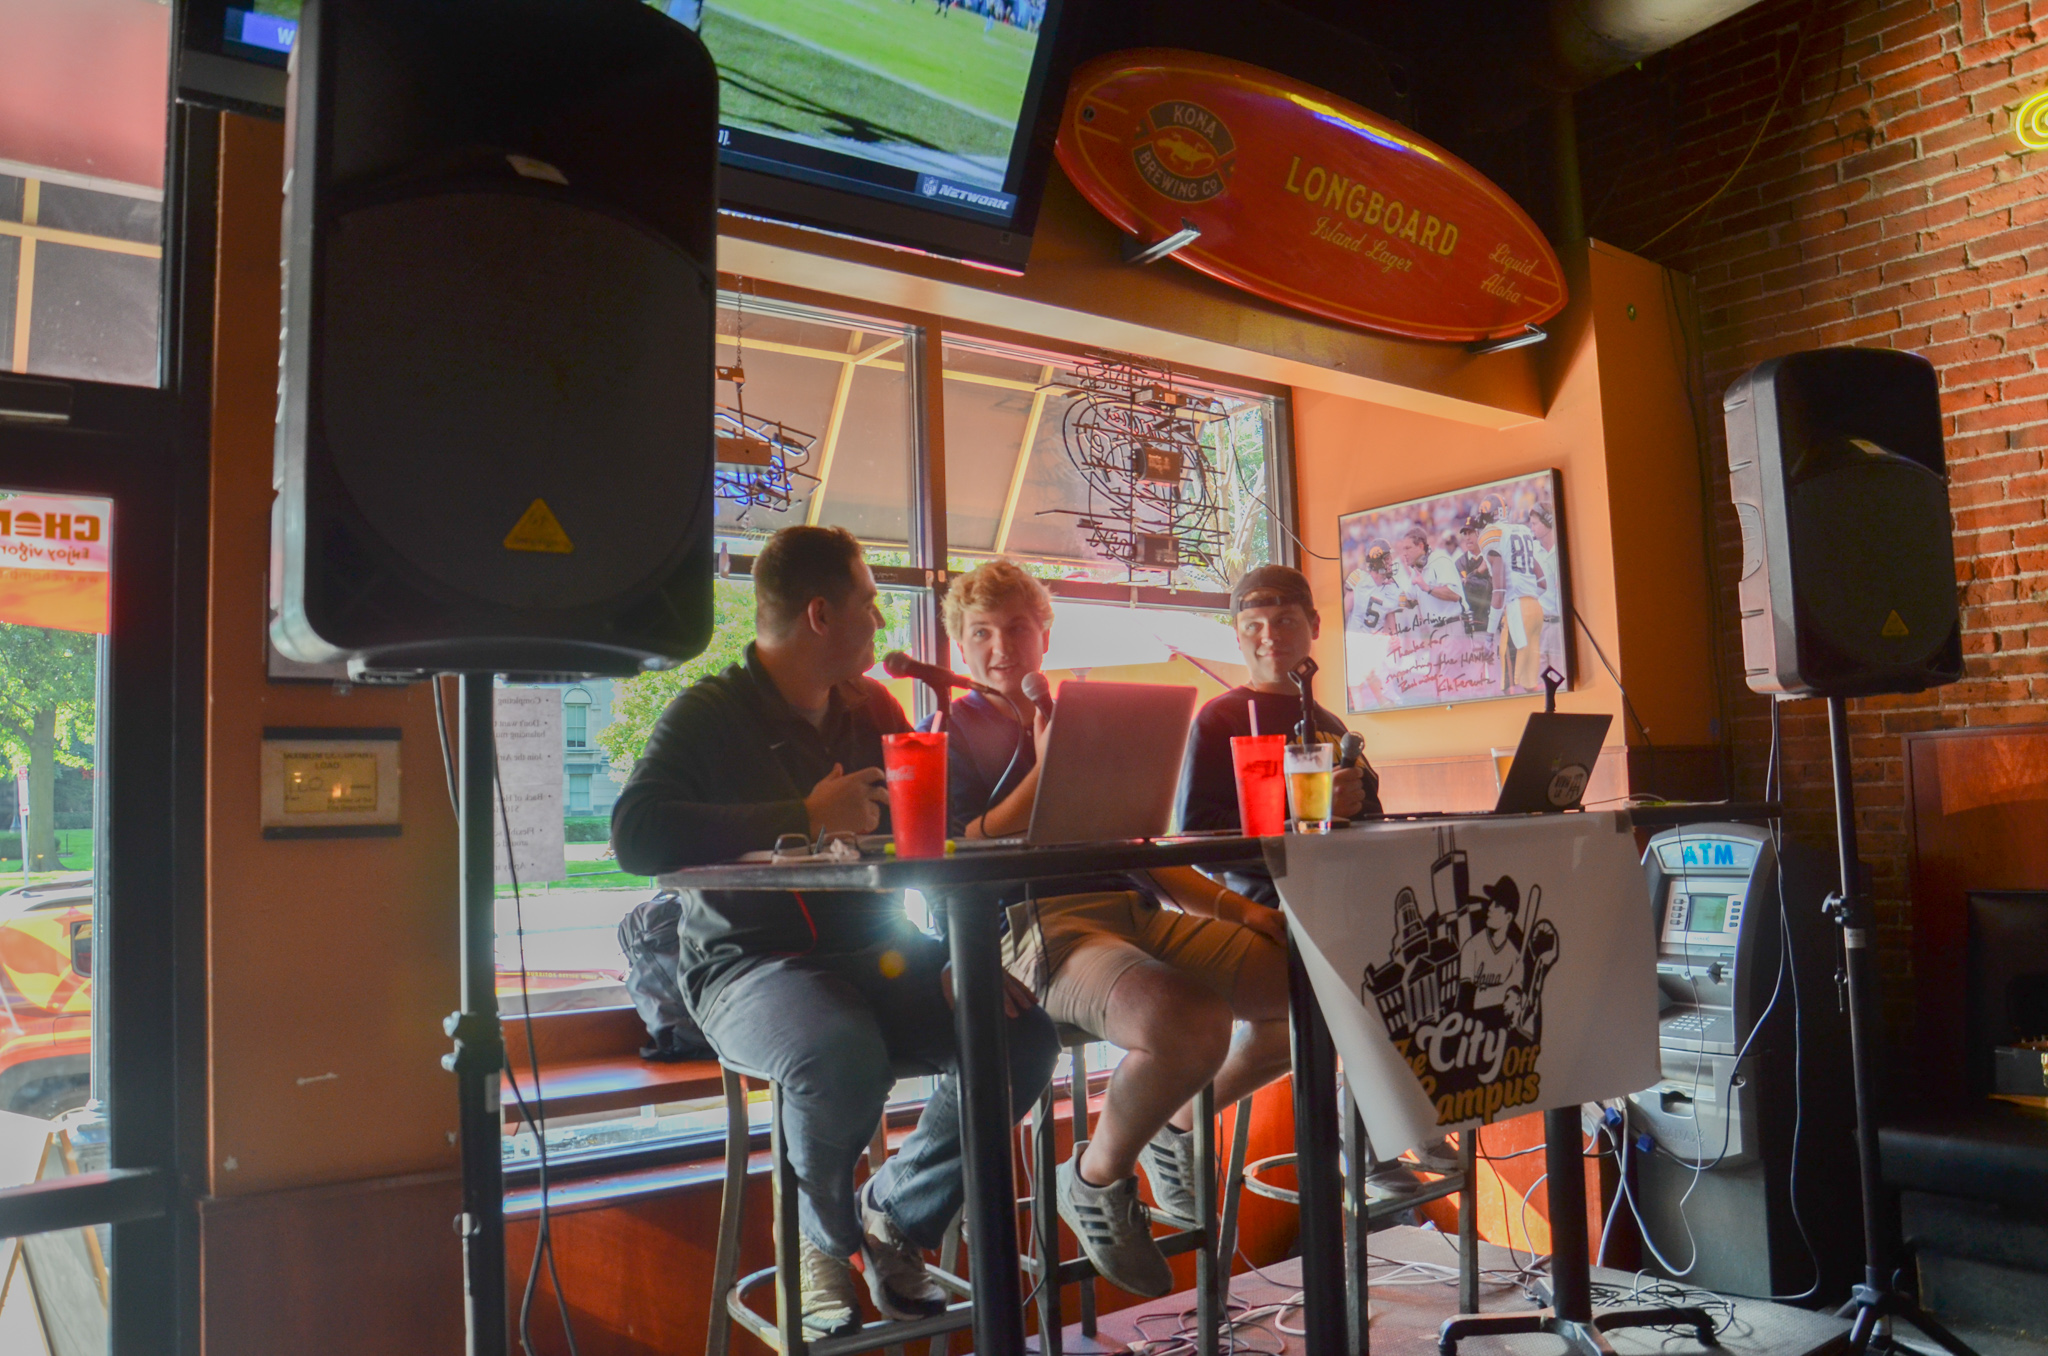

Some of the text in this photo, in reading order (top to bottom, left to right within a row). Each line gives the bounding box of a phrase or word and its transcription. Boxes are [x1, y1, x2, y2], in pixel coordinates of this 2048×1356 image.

[1173, 104, 1217, 139] KONA
[1139, 150, 1197, 198] BREWING
[938, 184, 1010, 210] NETWORK
[1284, 155, 1459, 257] LONGBOARD
[1310, 215, 1413, 273] Island Lager
[1488, 242, 1540, 276] Liquid
[1480, 273, 1521, 304] Aloha
[1364, 596, 1384, 628] 5
[1683, 842, 1734, 865] ATM
[1415, 1012, 1508, 1083] City
[1502, 1045, 1540, 1077] Off
